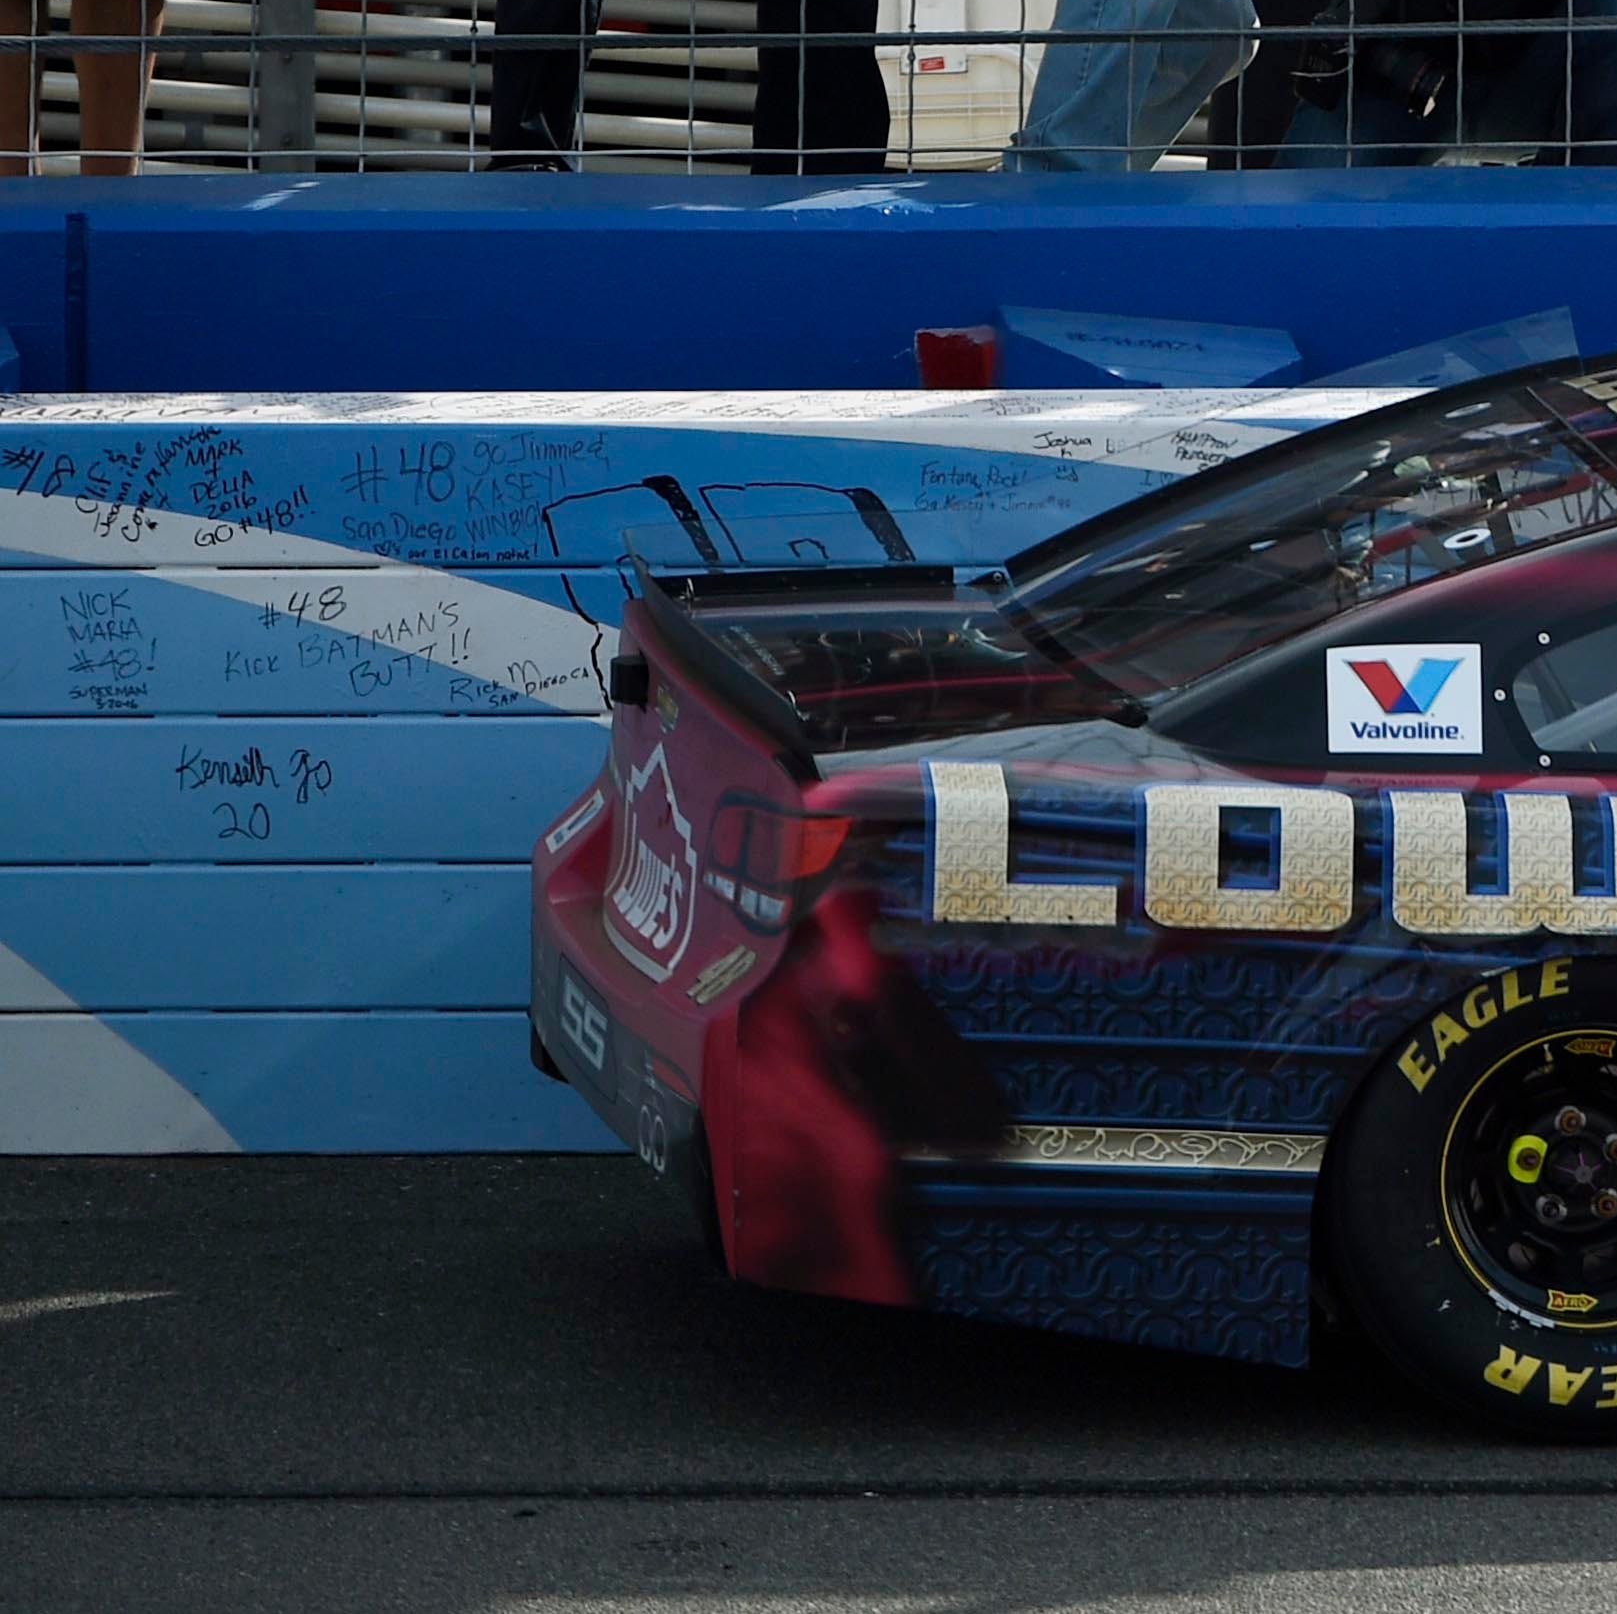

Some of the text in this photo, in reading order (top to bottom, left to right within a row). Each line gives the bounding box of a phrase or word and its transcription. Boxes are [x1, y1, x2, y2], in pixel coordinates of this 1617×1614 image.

[184, 439, 244, 467] MARK
[1033, 431, 1093, 450] Joshua
[205, 493, 257, 521] 2016
[60, 587, 132, 621] NICK
[258, 584, 348, 631] #48
[298, 600, 460, 669] BATMAN'S
[68, 682, 148, 700] SUPERMAN
[488, 691, 520, 710] SAN
[1350, 719, 1459, 741] Valvoline
[212, 801, 271, 841] 20
[1396, 955, 1574, 1096] EAGLE
